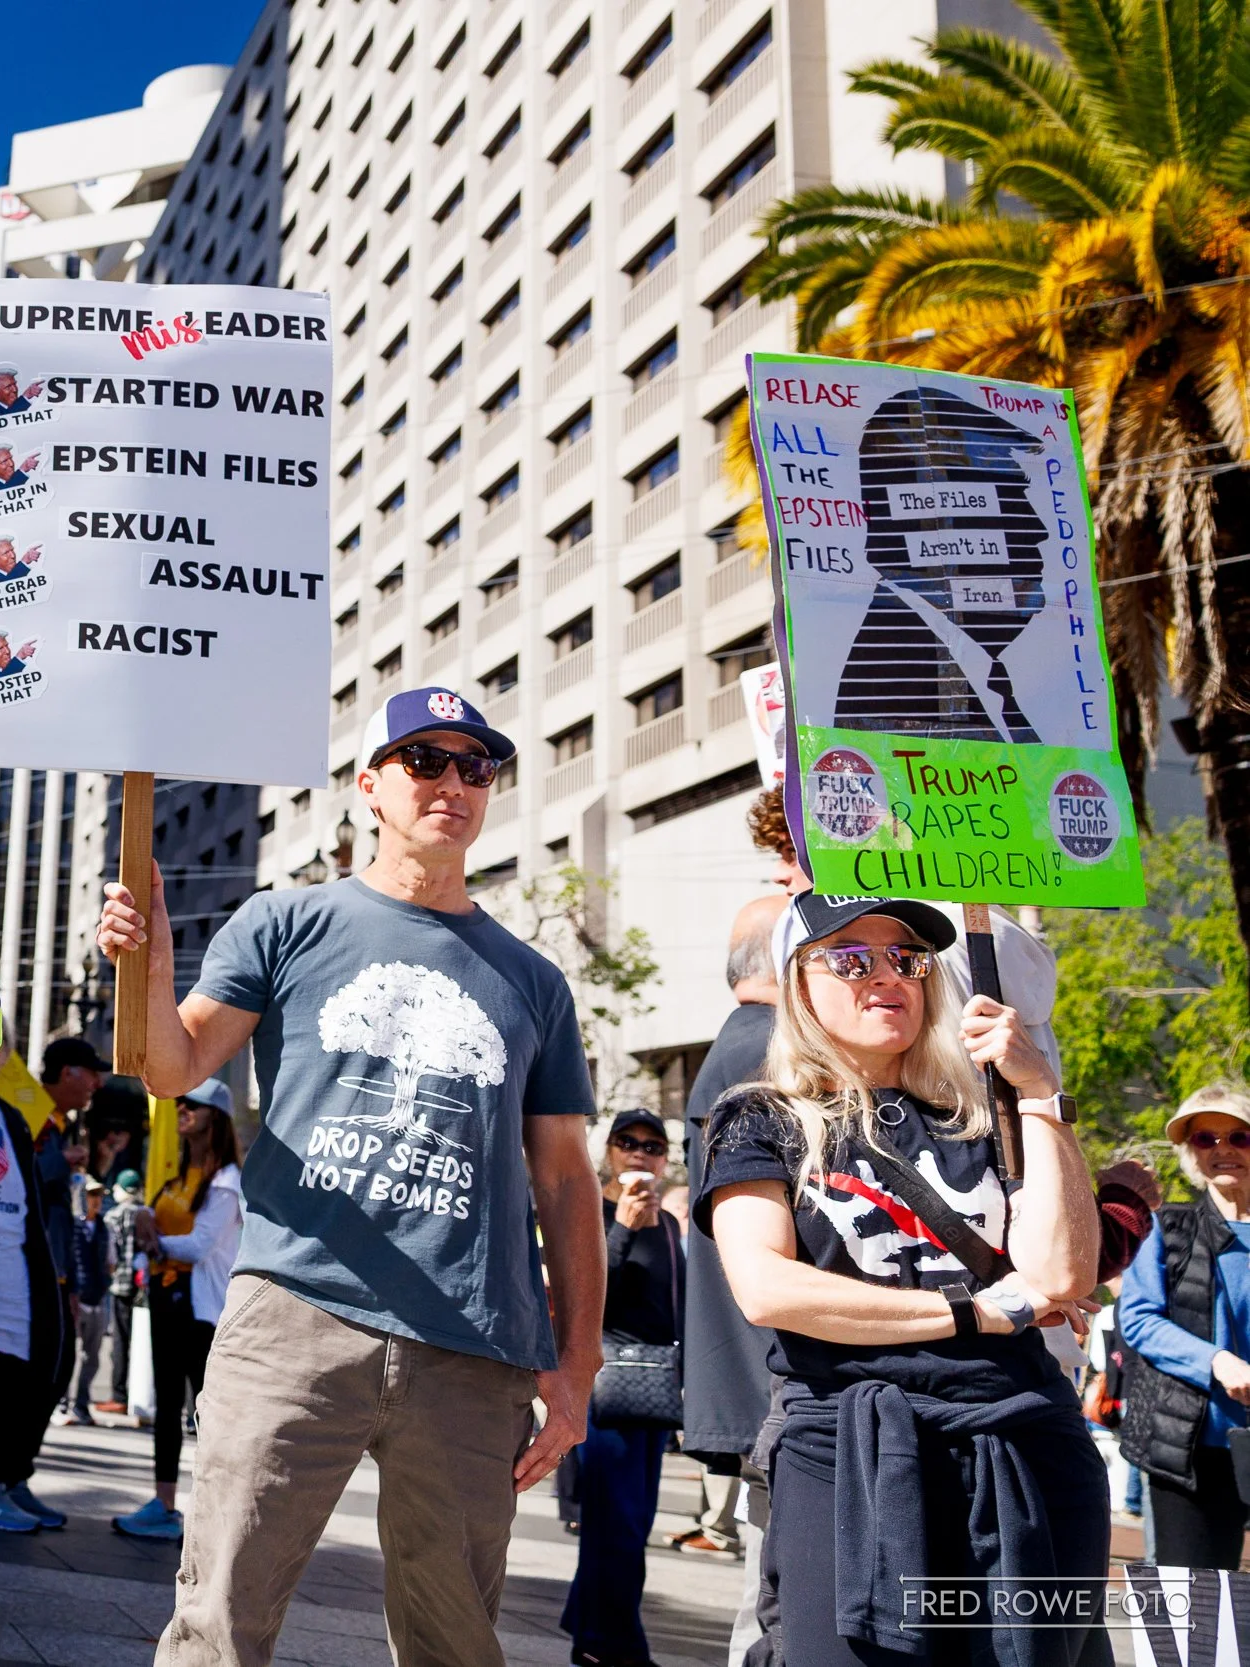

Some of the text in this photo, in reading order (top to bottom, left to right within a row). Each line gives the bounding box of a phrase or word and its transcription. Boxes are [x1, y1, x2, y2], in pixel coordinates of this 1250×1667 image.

[120, 315, 203, 361] mis
[47, 377, 325, 417] STARTED WAR
[765, 378, 861, 408] RELASE
[12, 409, 53, 425] THAT
[1043, 424, 1057, 441] A
[773, 422, 839, 457] ALL
[53, 445, 318, 487] EPSTEIN FILES
[780, 463, 834, 488] THE
[6, 488, 26, 500] UP
[30, 483, 47, 495] IN
[900, 491, 987, 510] The Files
[776, 496, 871, 527] EPSTEIN
[68, 511, 215, 546] SEXUAL
[786, 538, 853, 574] FILES
[980, 538, 999, 555] in
[5, 575, 47, 594] GRAB
[149, 558, 324, 600] ASSAULT
[963, 587, 1003, 603] Iran
[78, 622, 218, 658] RACIST
[818, 775, 875, 795] FUCK
[891, 750, 1017, 797] TRUMP
[891, 802, 1010, 841] RAPES
[1059, 798, 1106, 819] FUCK
[1060, 819, 1108, 835] TRUMP
[306, 1126, 474, 1189] DROP SEEDS
[299, 1162, 471, 1220] NOT BOMBS
